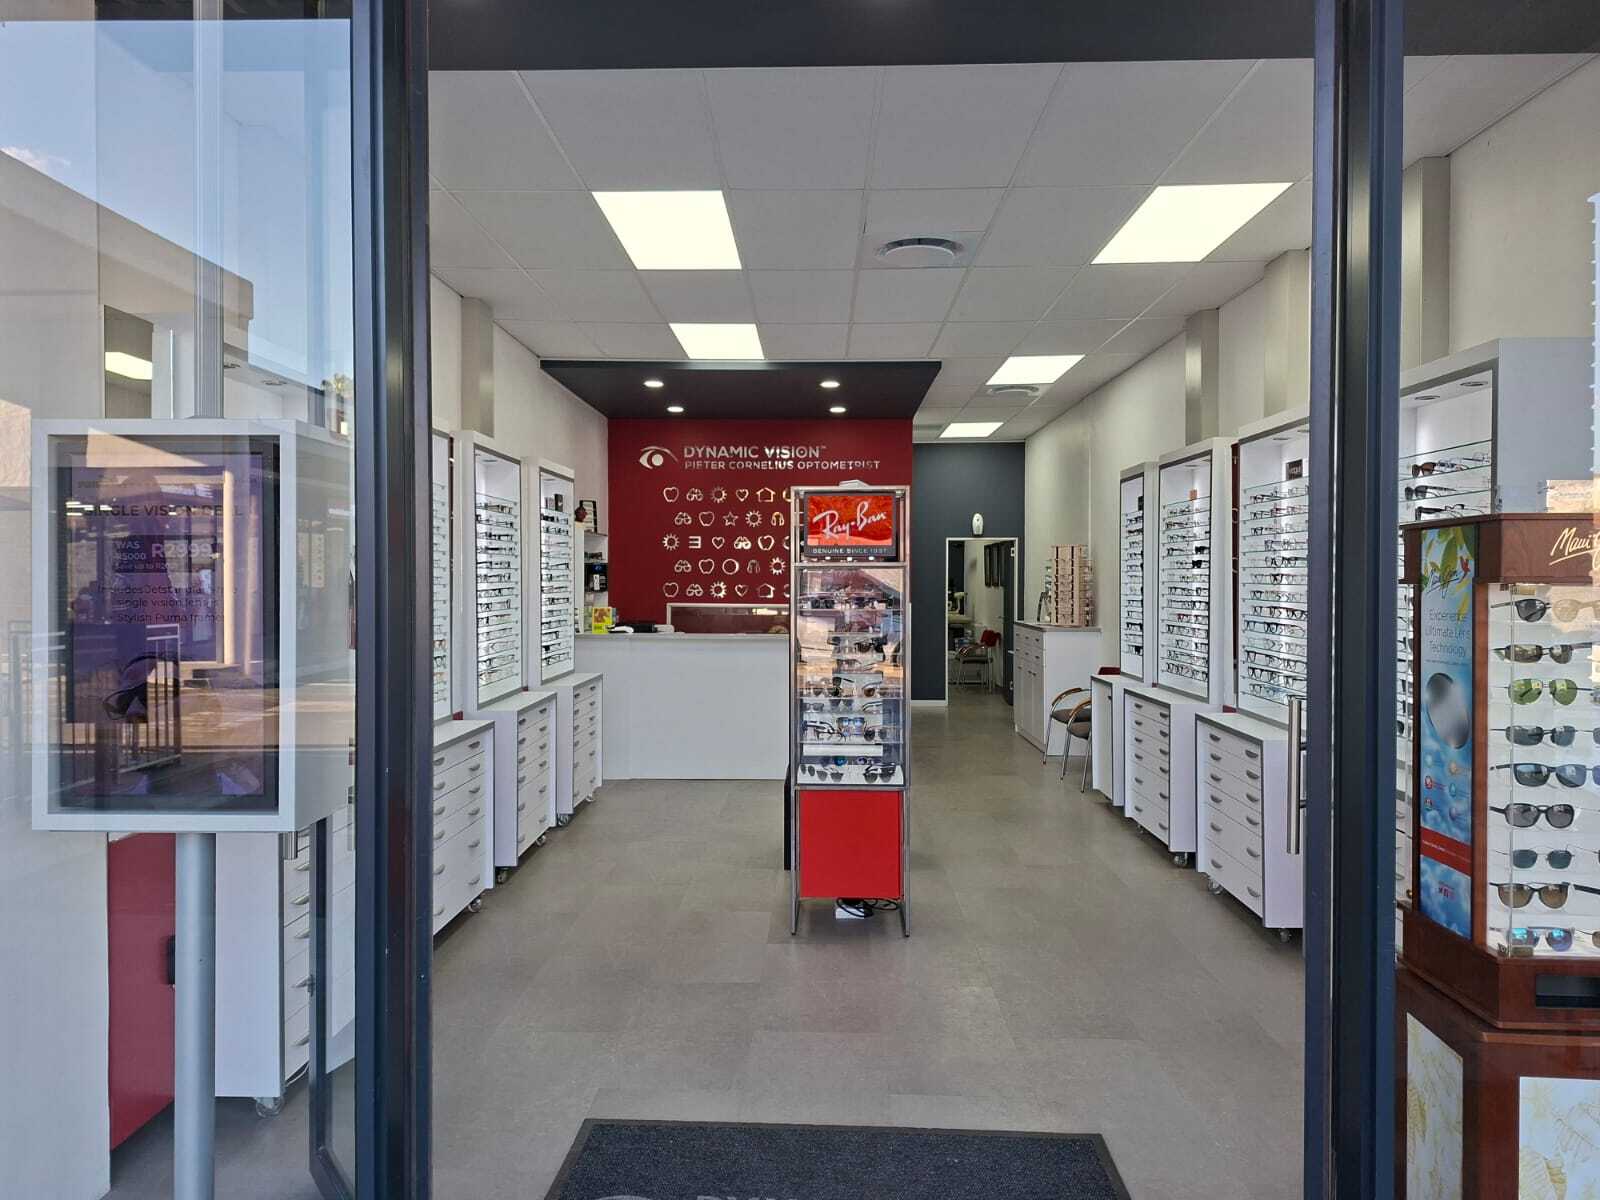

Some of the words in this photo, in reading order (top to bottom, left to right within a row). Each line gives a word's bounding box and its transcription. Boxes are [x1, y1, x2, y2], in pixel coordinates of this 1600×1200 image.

[683, 446, 760, 459] DYNAMIC
[685, 461, 725, 470] PIETER
[729, 461, 794, 470] CORNELIUS
[797, 460, 881, 470] OPTOMETRIST
[200, 504, 243, 517] DEL
[812, 500, 887, 540] Ray-Ban
[1549, 526, 1592, 557] Maui
